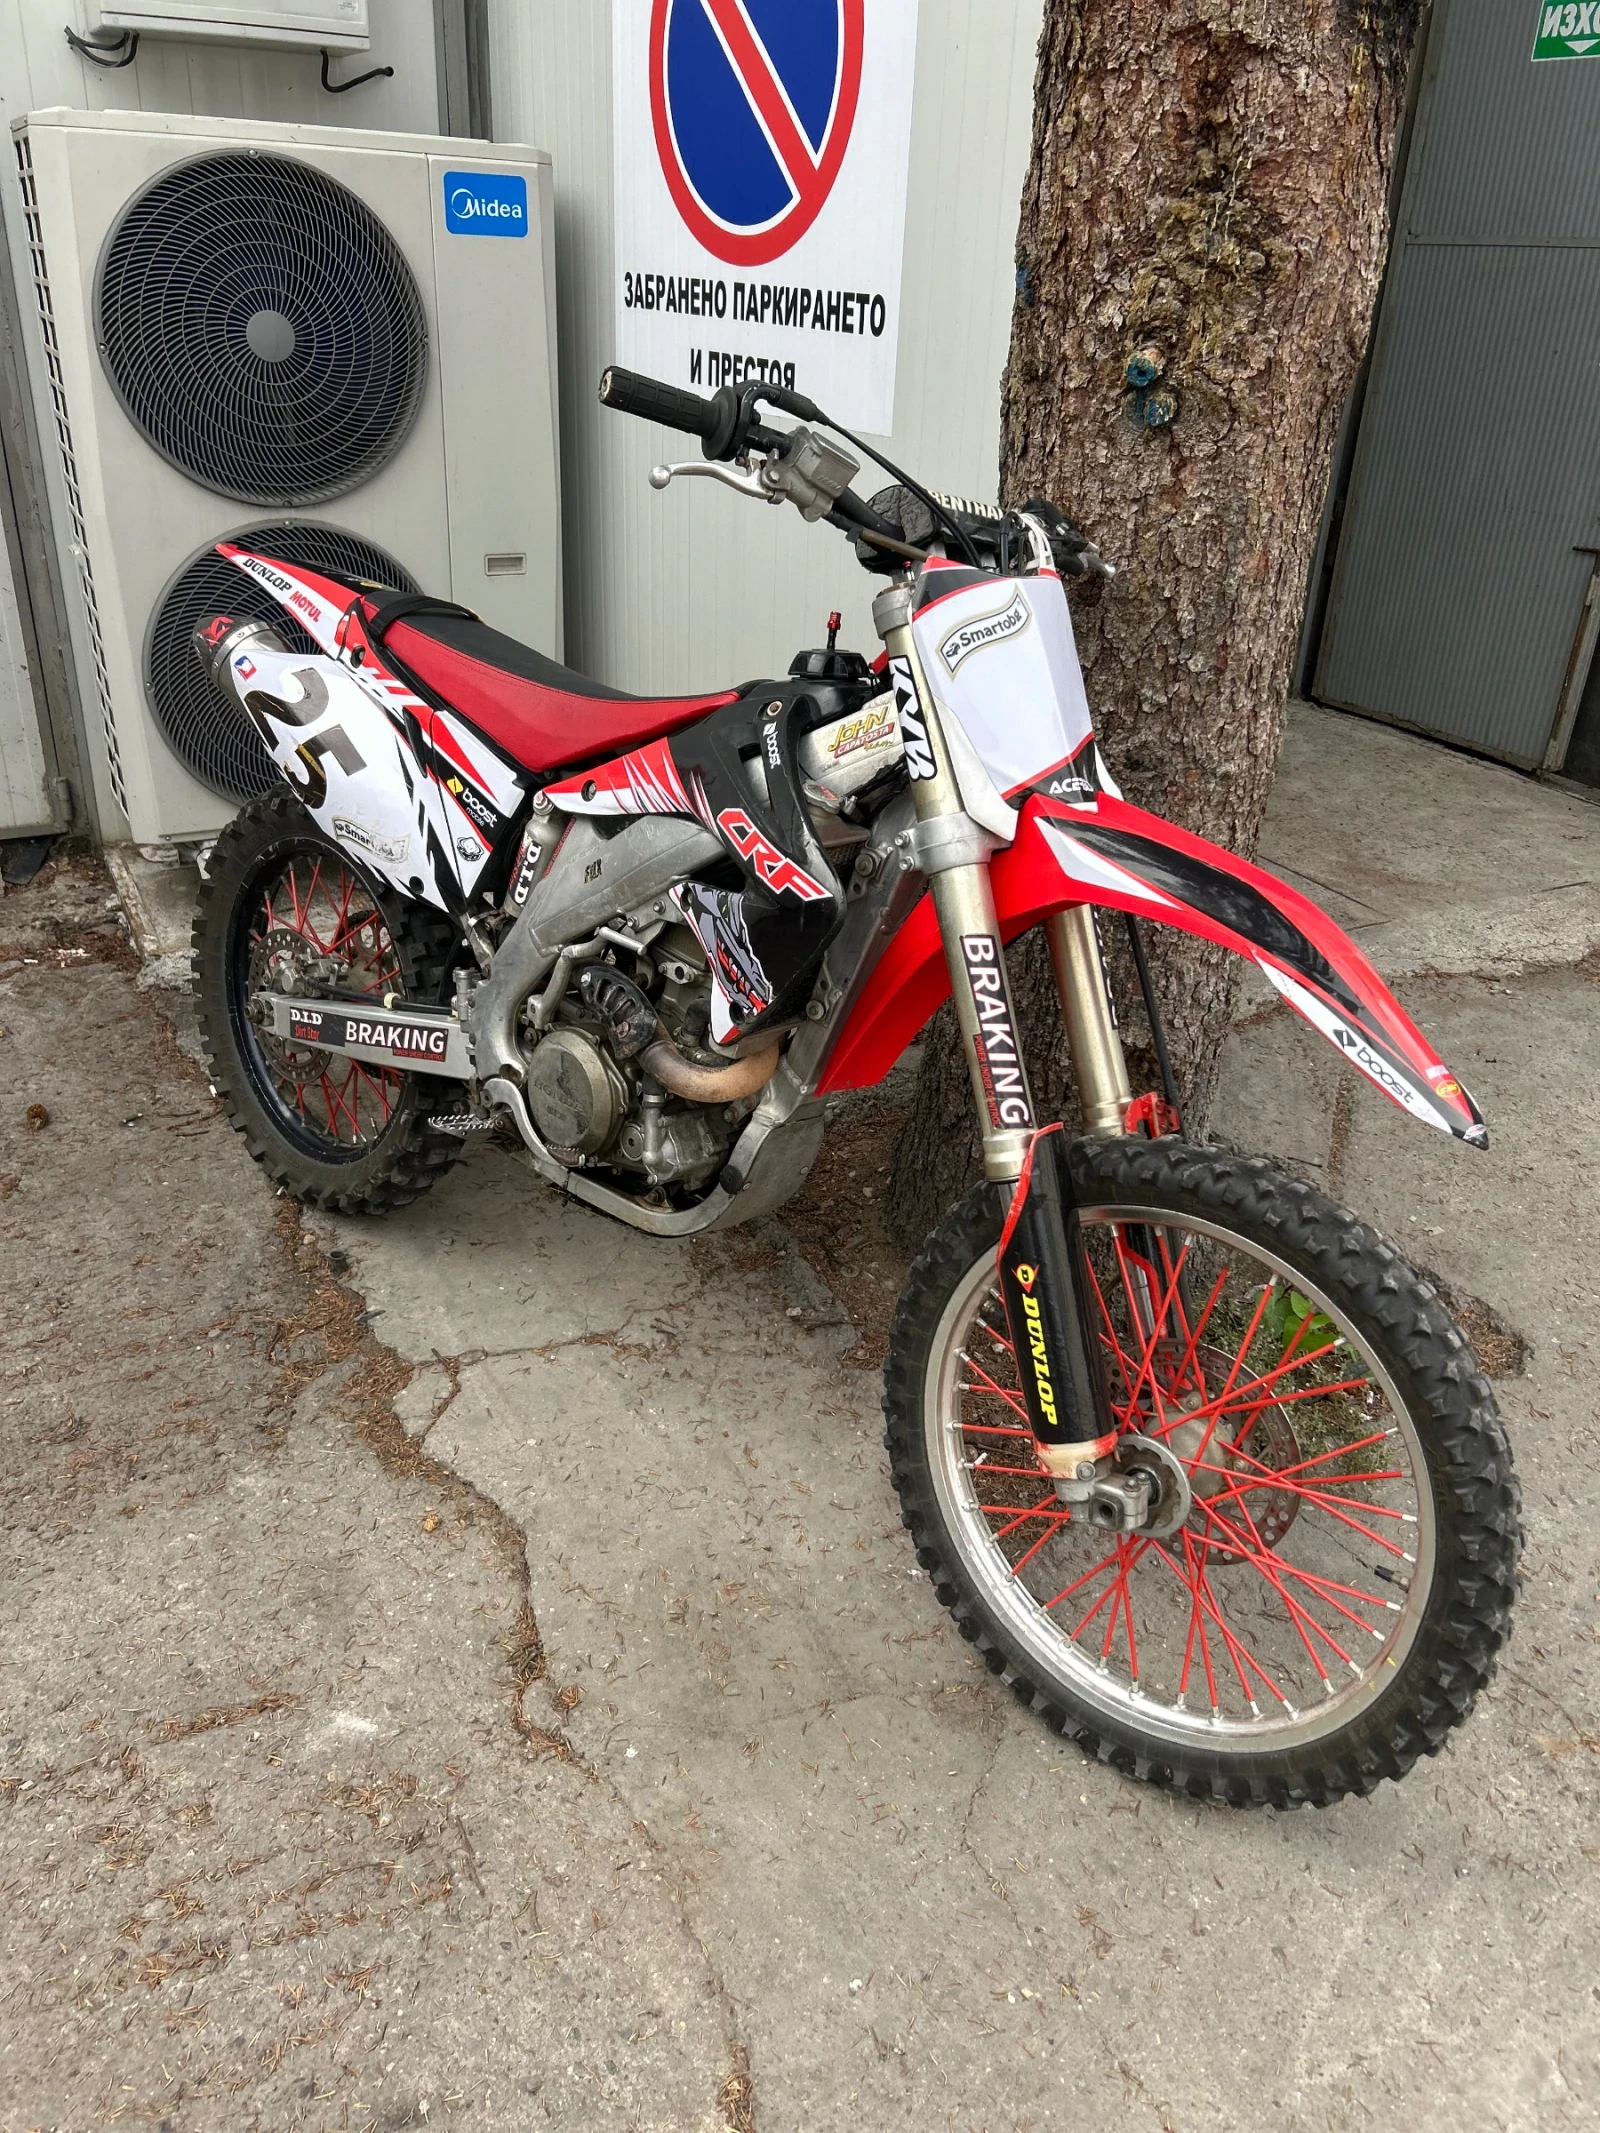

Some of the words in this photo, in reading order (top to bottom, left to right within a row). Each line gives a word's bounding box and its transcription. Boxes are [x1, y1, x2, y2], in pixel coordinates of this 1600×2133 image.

[455, 193, 522, 218] Midea
[624, 271, 727, 319] ЗАБРАНЕНО
[733, 281, 886, 337] ПАРКИРАНЕТО
[690, 348, 702, 384] И
[242, 558, 293, 592] DUNLOP
[289, 590, 322, 623] MOTUL
[959, 608, 1023, 648] Smartobg
[243, 667, 368, 809] 25
[828, 706, 888, 752] JOHN
[888, 656, 935, 780] KYB
[766, 731, 781, 770] boost
[837, 725, 891, 755] CAPATOSTA
[462, 787, 498, 828] boost
[514, 841, 542, 905] D.I.D
[717, 808, 833, 901] CRF
[291, 1008, 323, 1026] D.I.D
[295, 1026, 307, 1037] Dirt
[345, 1020, 445, 1053] BRAKING
[963, 936, 1029, 1125] BRAKING
[975, 1036, 987, 1062] POWER
[980, 1062, 993, 1089] UNDER
[1357, 1046, 1414, 1104] boost
[1022, 1293, 1058, 1426] DUNLOP
